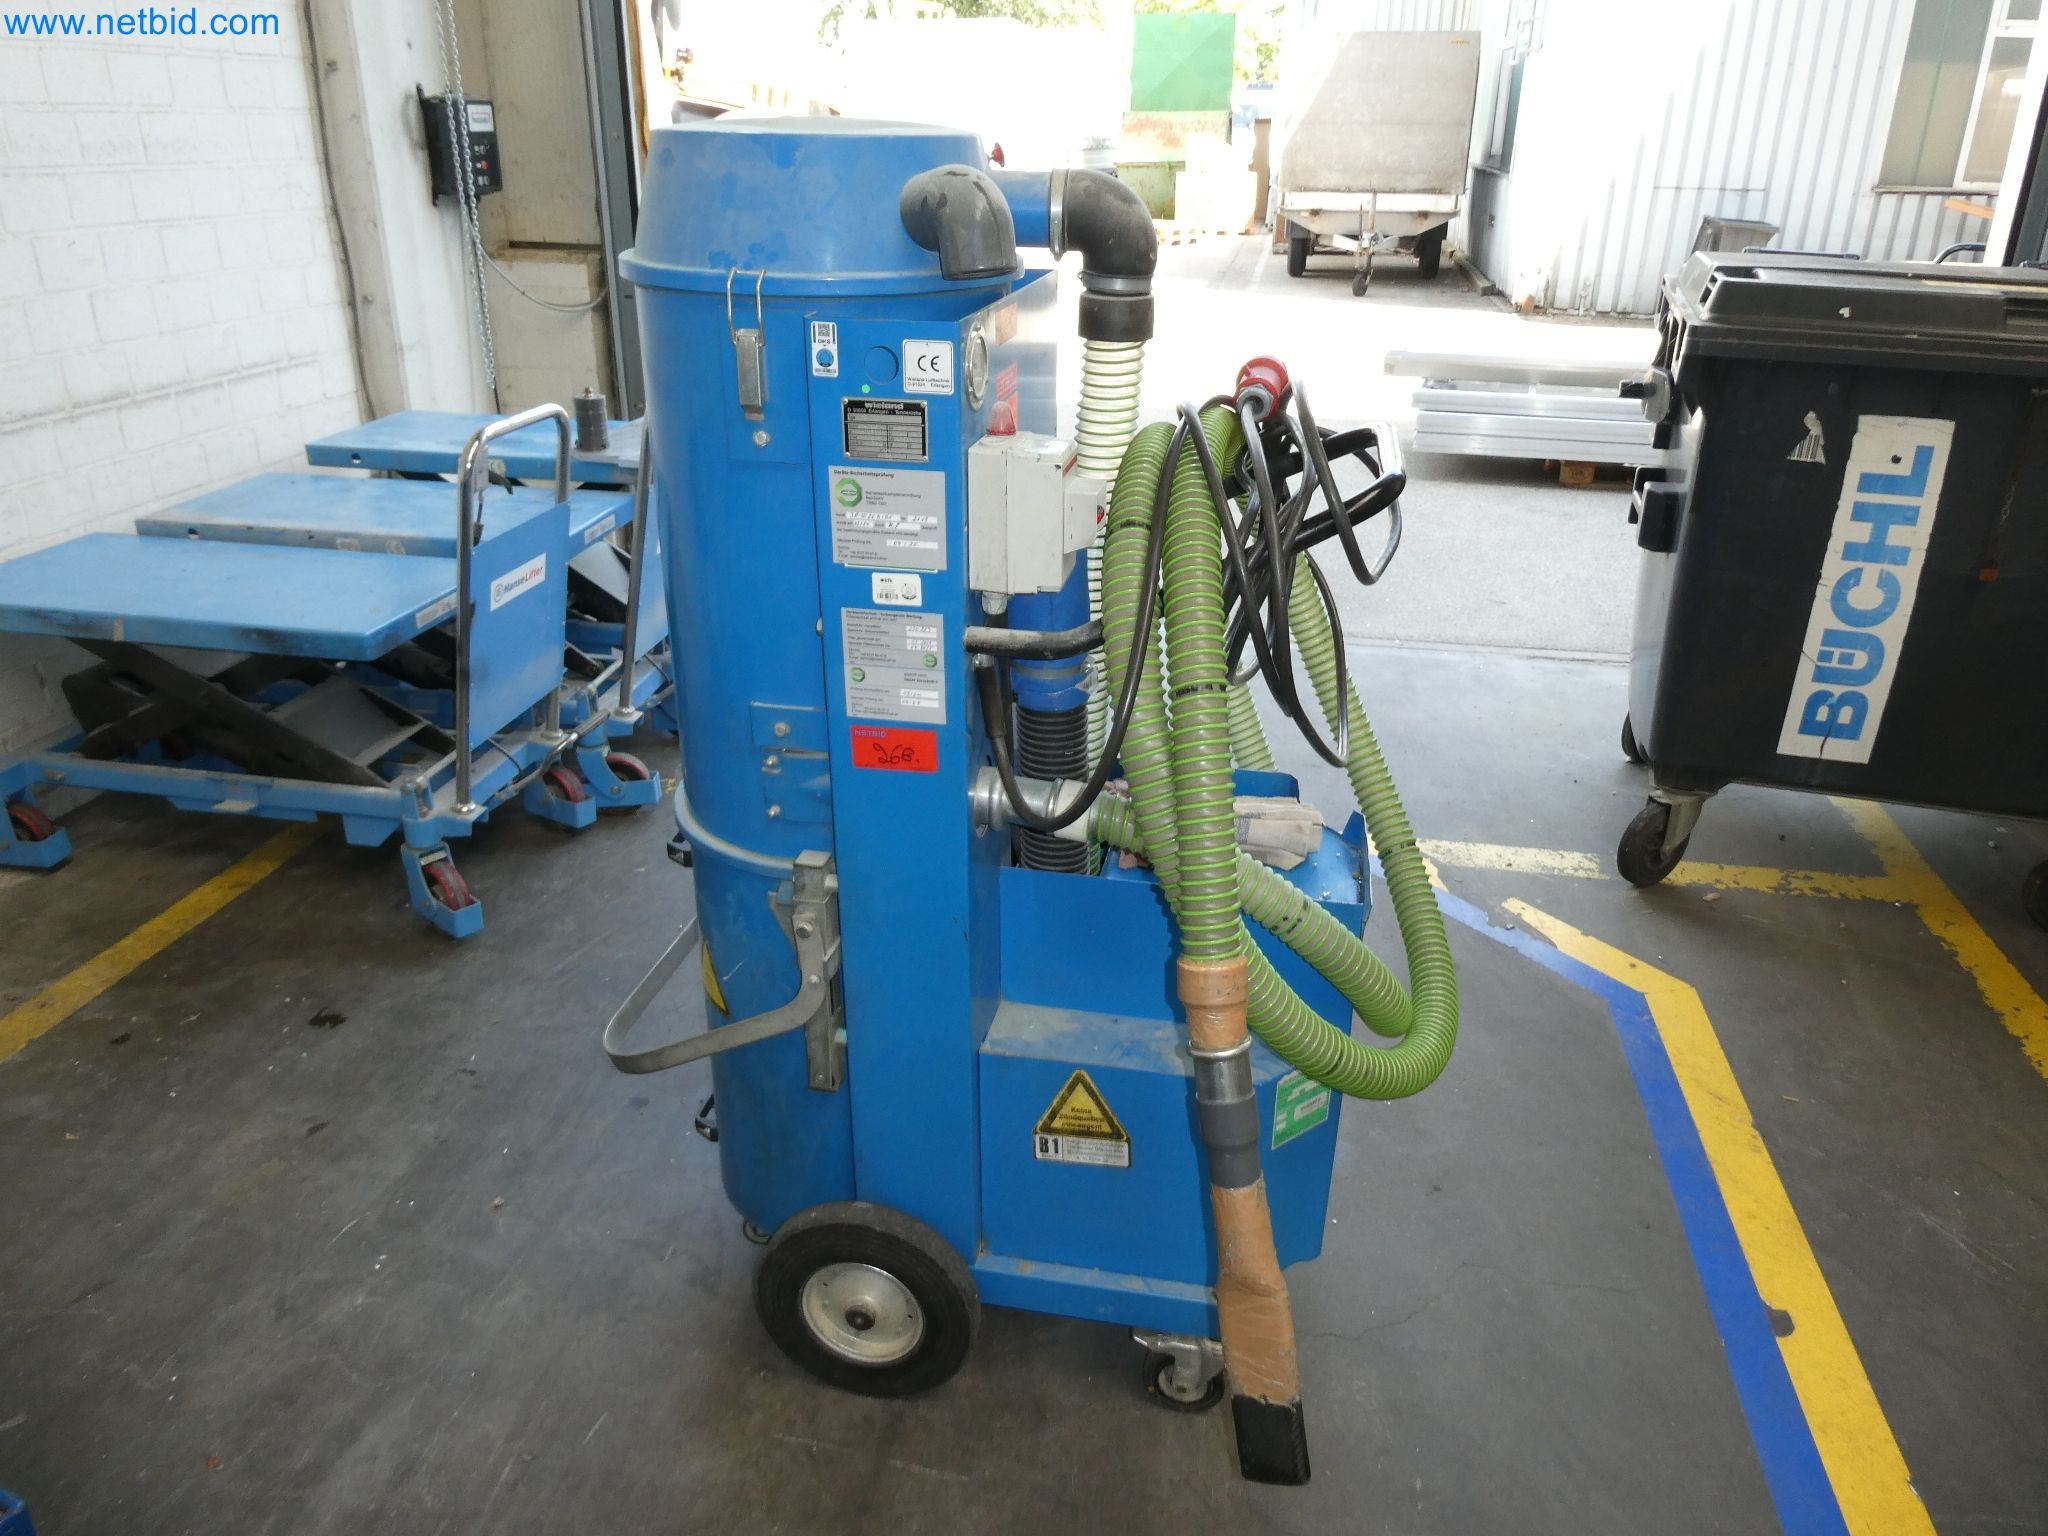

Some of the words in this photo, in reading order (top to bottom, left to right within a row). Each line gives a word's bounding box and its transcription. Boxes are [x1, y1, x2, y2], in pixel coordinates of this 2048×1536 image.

[917, 354, 940, 373] CE
[864, 401, 904, 410] wieland
[503, 565, 544, 594] HanseLifter
[1798, 445, 1935, 742] BÜCHL
[854, 729, 887, 738] NETBID
